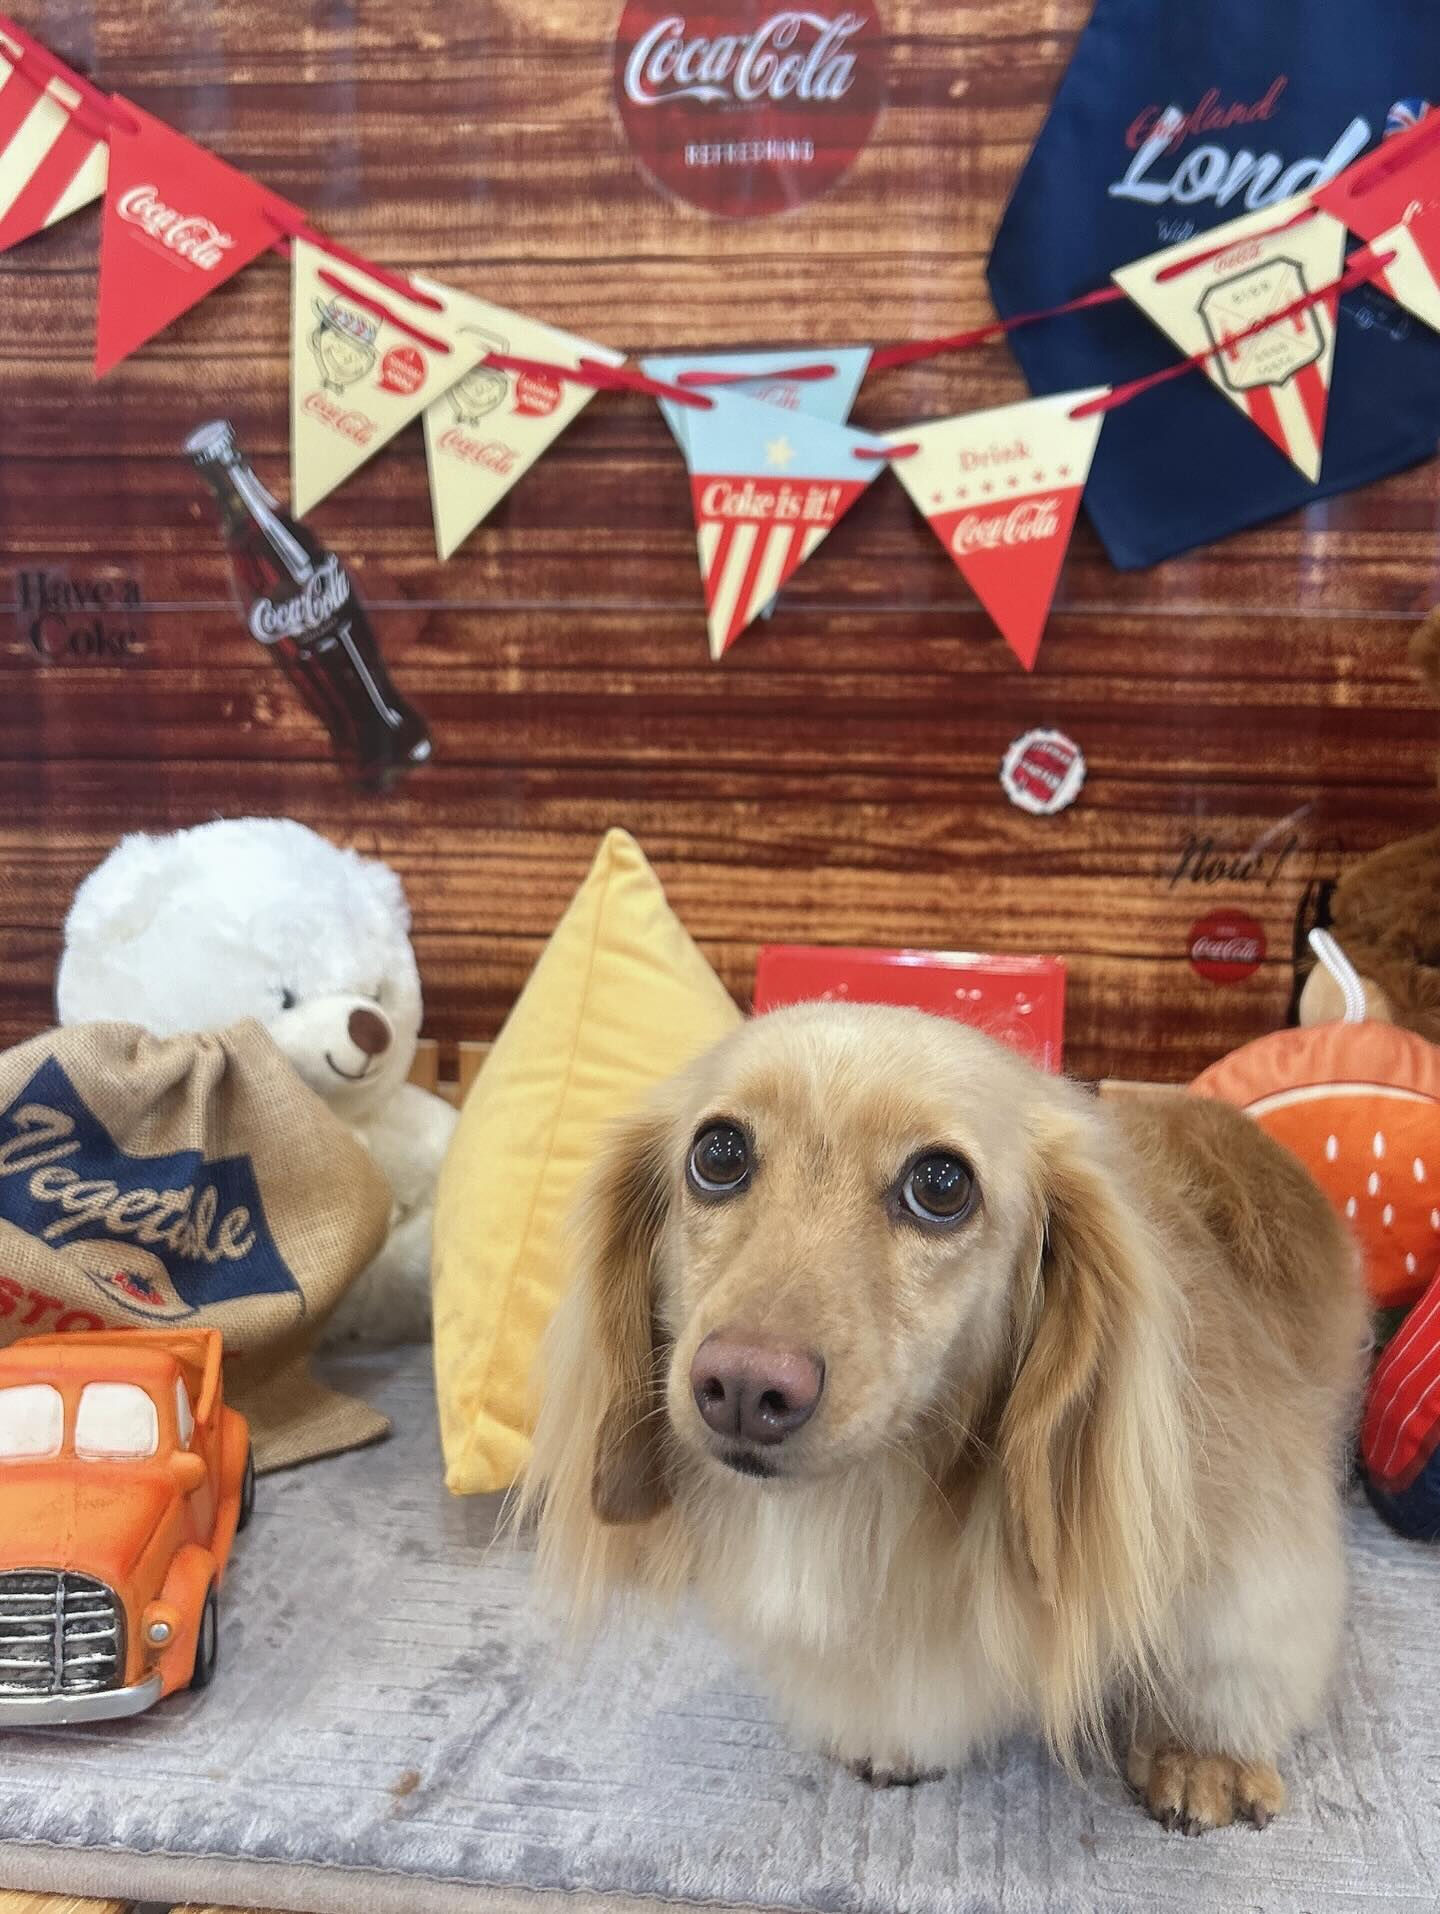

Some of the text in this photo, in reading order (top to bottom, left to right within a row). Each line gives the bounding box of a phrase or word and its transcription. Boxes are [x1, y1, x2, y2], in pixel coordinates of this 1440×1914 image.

[624, 10, 868, 106] Coca-Cola
[960, 437, 1030, 472] Drink
[702, 478, 843, 522] Coke is it!
[19, 571, 115, 611] Have
[30, 611, 140, 658] Coke
